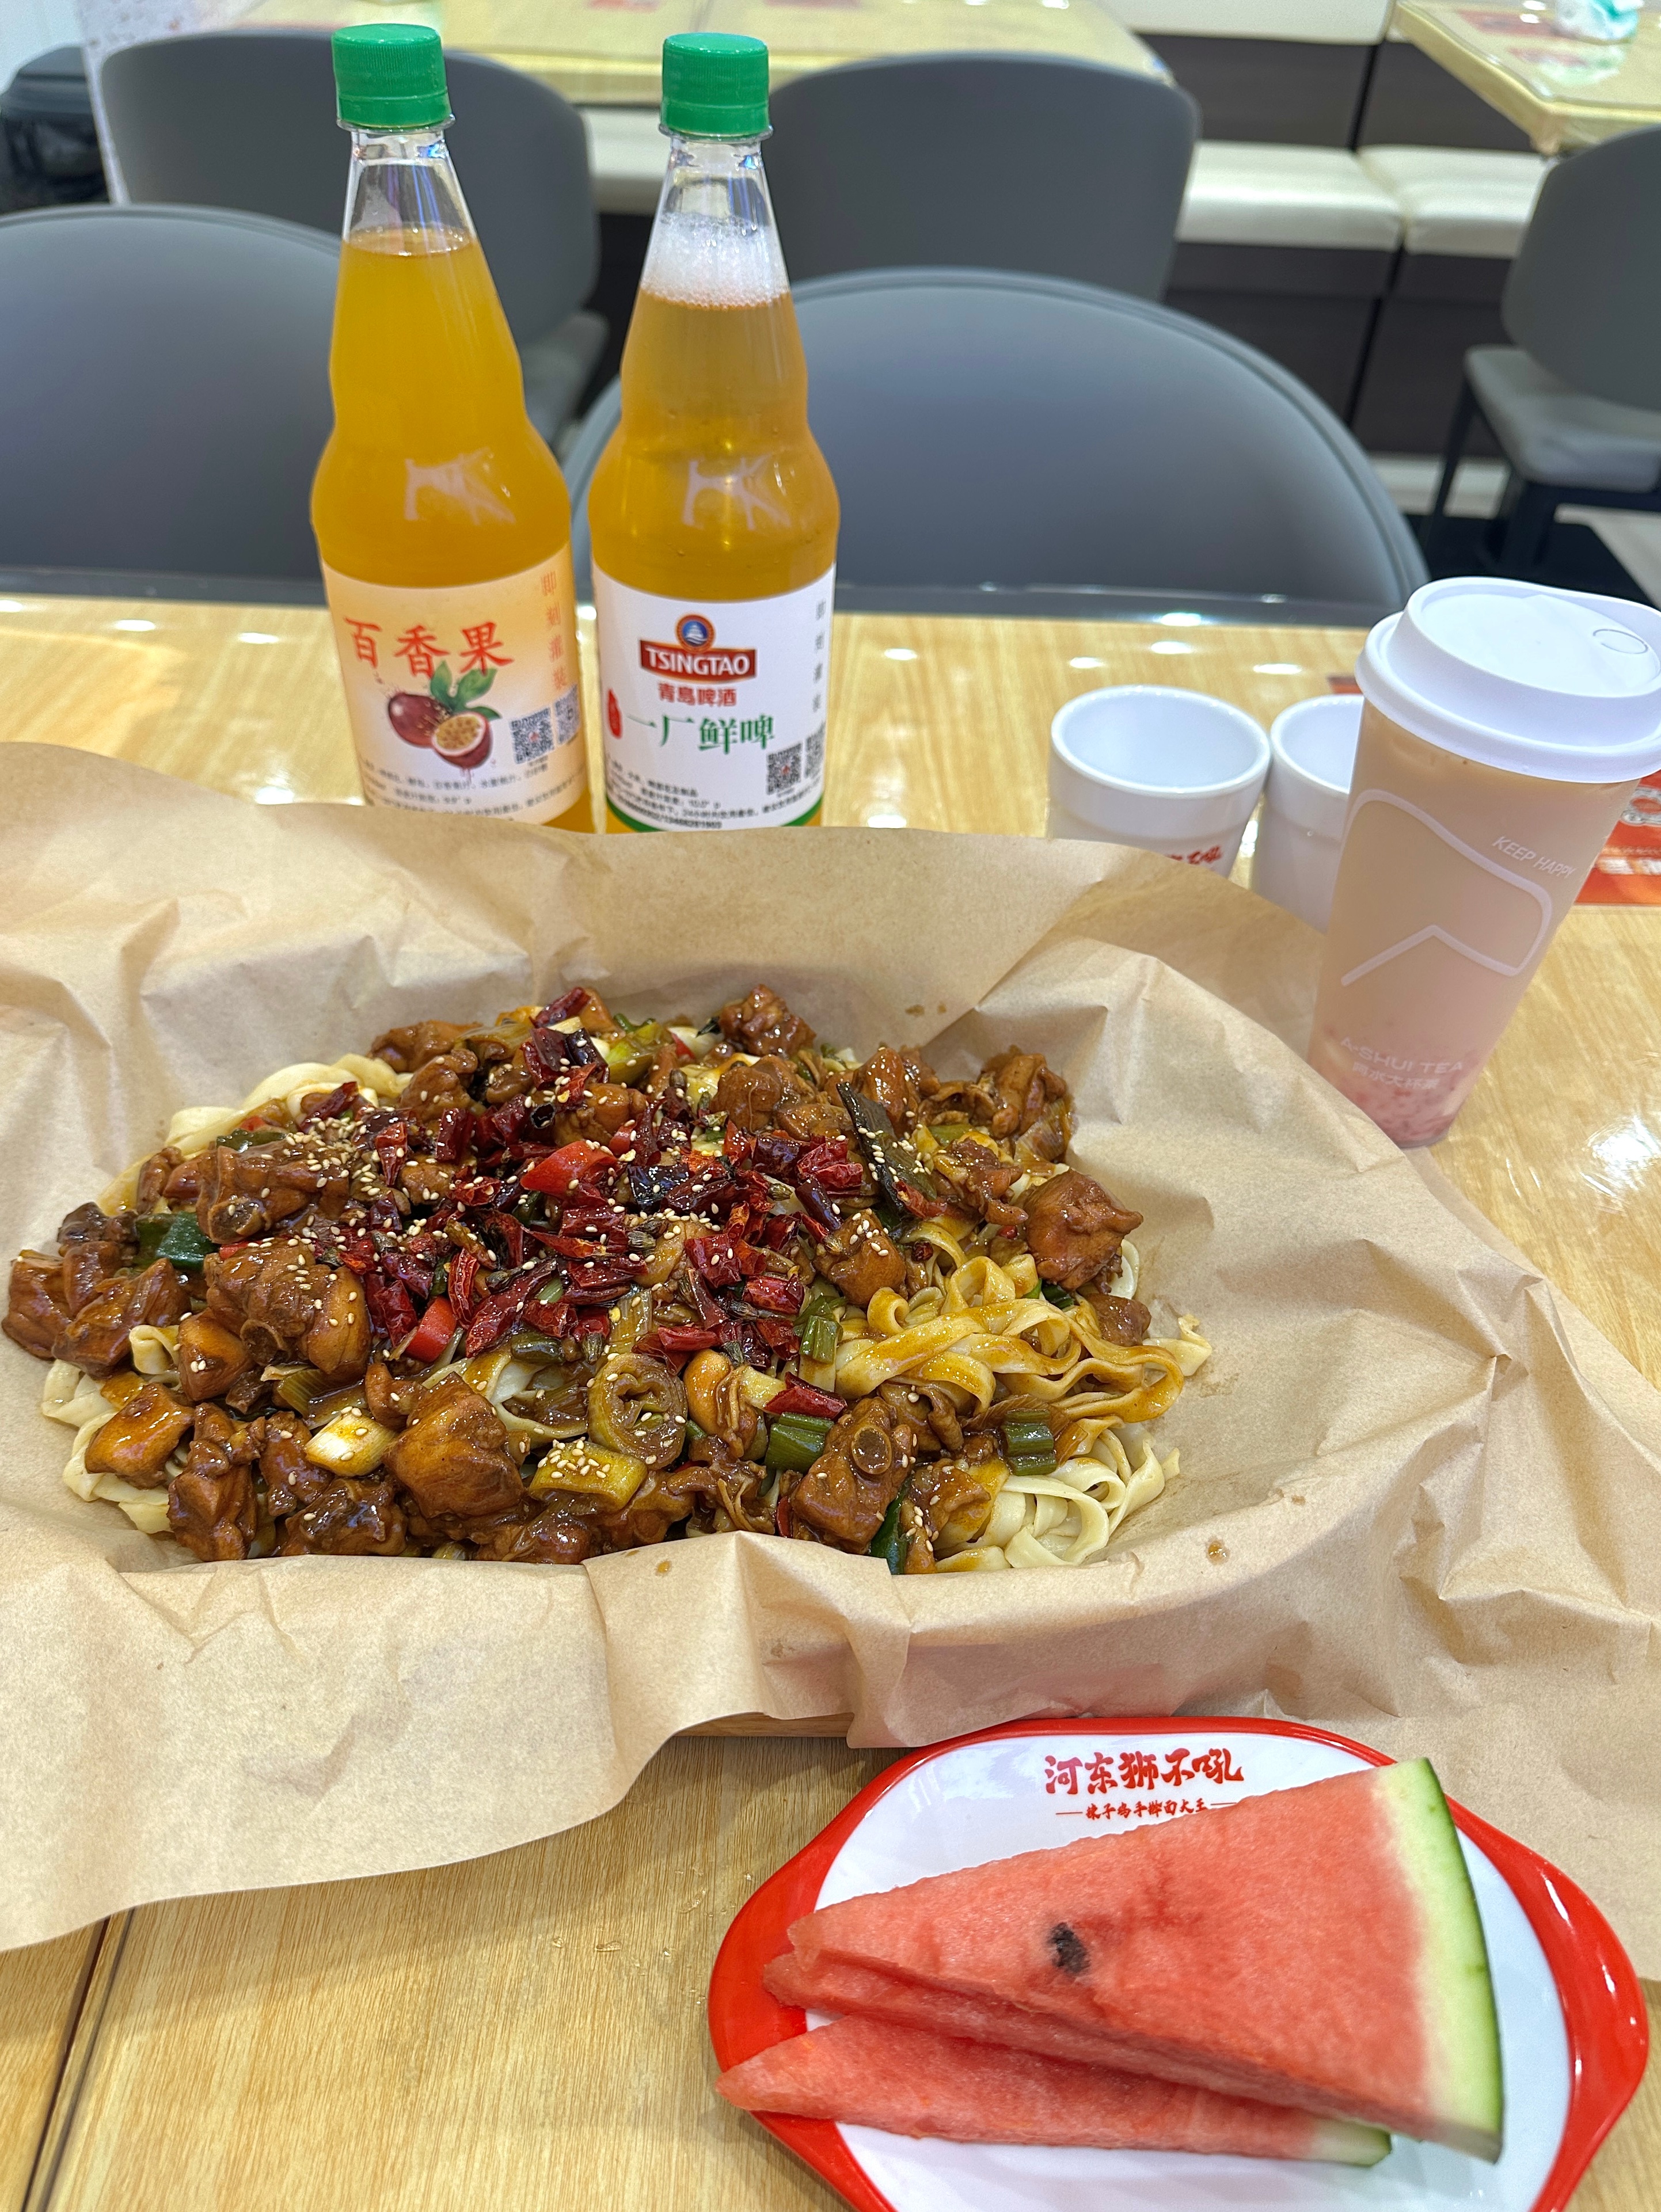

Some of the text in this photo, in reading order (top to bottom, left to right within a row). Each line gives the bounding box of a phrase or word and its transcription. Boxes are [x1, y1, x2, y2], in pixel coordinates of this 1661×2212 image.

[344, 618, 515, 679] 百香果
[644, 646, 751, 676] TSINGTAO
[626, 714, 776, 755] 一厂鲜啤
[1492, 836, 1537, 861] KEEP
[1533, 856, 1578, 878] HAPPY
[1341, 1037, 1464, 1074] A-SHUI TEA
[1044, 1747, 1244, 1795] 河东狮不吼
